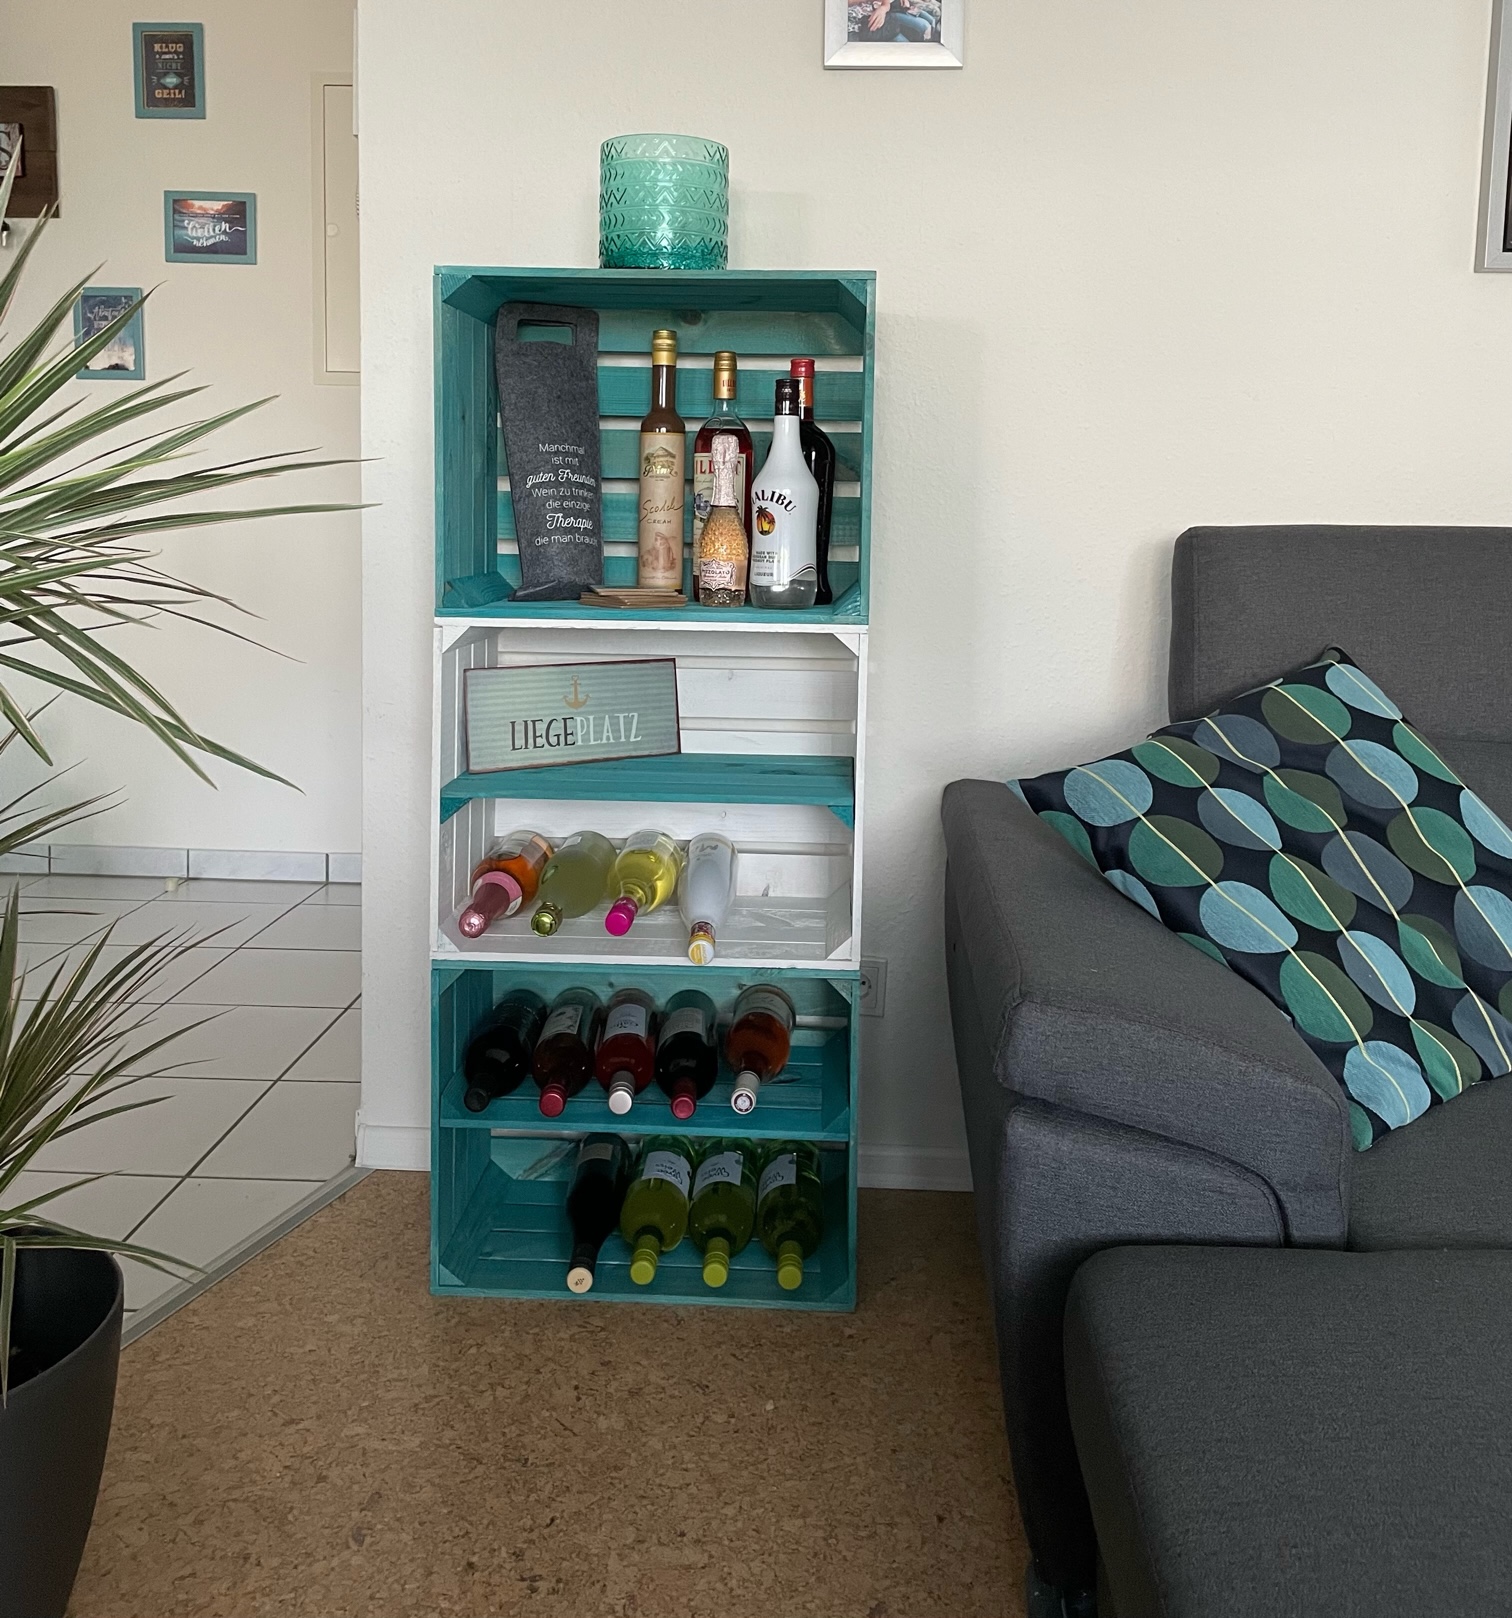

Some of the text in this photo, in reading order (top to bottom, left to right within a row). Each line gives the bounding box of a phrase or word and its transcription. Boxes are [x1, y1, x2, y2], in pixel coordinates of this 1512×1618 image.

[153, 43, 184, 52] KLUG
[155, 89, 186, 98] GEIL!
[551, 456, 579, 466] ist mit
[525, 471, 556, 489] guten
[531, 488, 557, 498] Wein
[559, 487, 571, 496] zu
[546, 500, 561, 509] die
[546, 513, 594, 531] Therapie
[535, 536, 549, 546] die
[551, 534, 574, 543] man
[509, 712, 642, 751] LIEGEPLATZ
